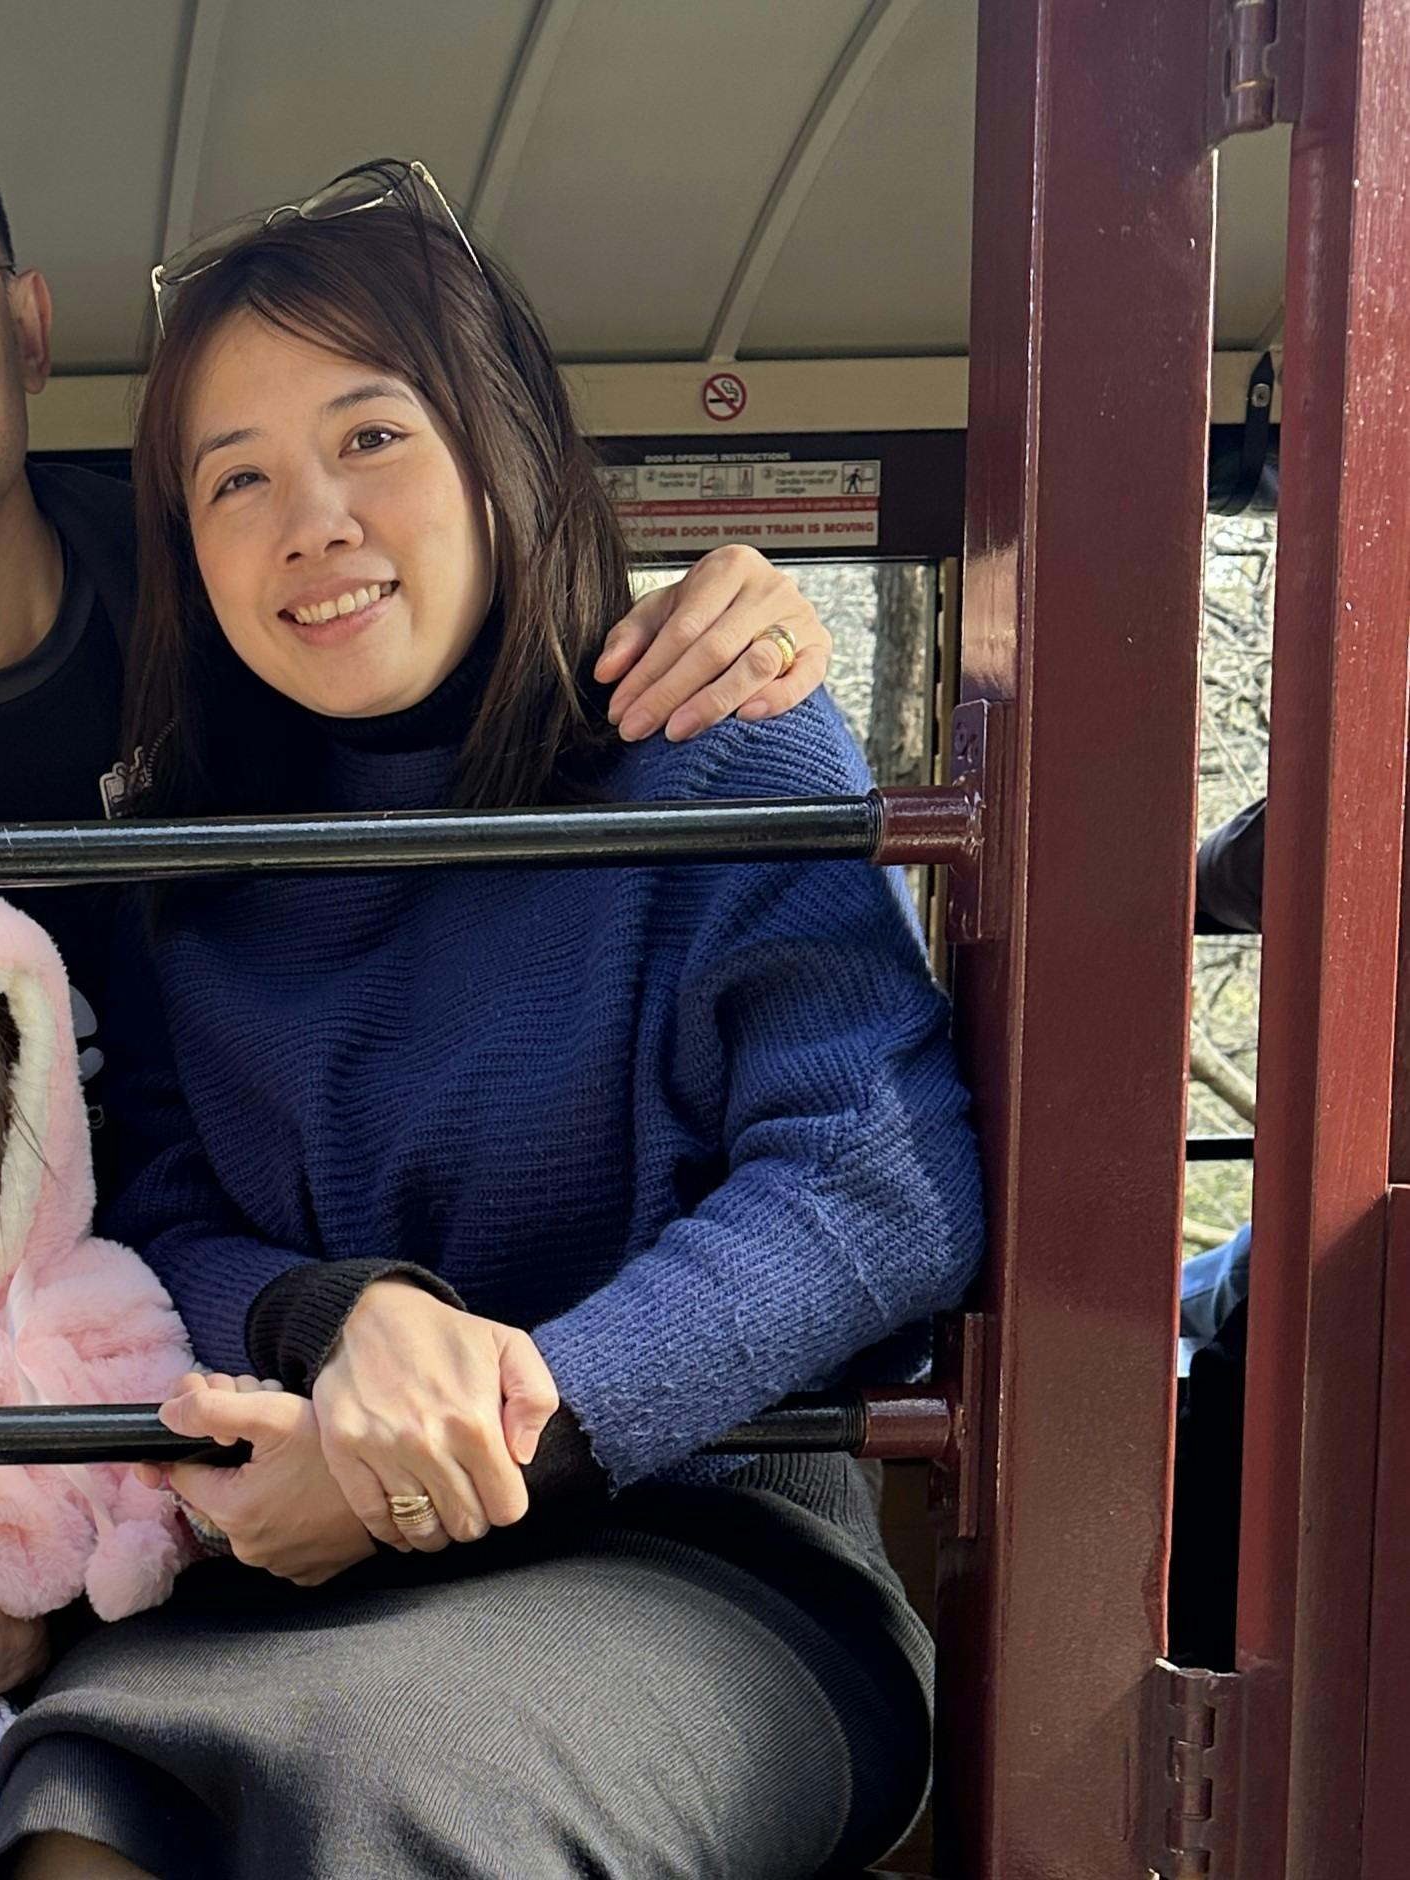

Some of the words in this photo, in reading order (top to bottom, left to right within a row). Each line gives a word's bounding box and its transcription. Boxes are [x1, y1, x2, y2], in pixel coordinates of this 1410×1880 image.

[645, 455, 673, 464] DOOR
[675, 454, 718, 462] OPENING
[720, 452, 791, 461] INSTRUCTIONS
[642, 527, 677, 538] OPEN
[681, 526, 719, 537] DOOR
[722, 524, 761, 536] WHEN
[766, 523, 804, 535] TRAIN
[808, 522, 821, 533] IS
[824, 521, 874, 533] MOVING
